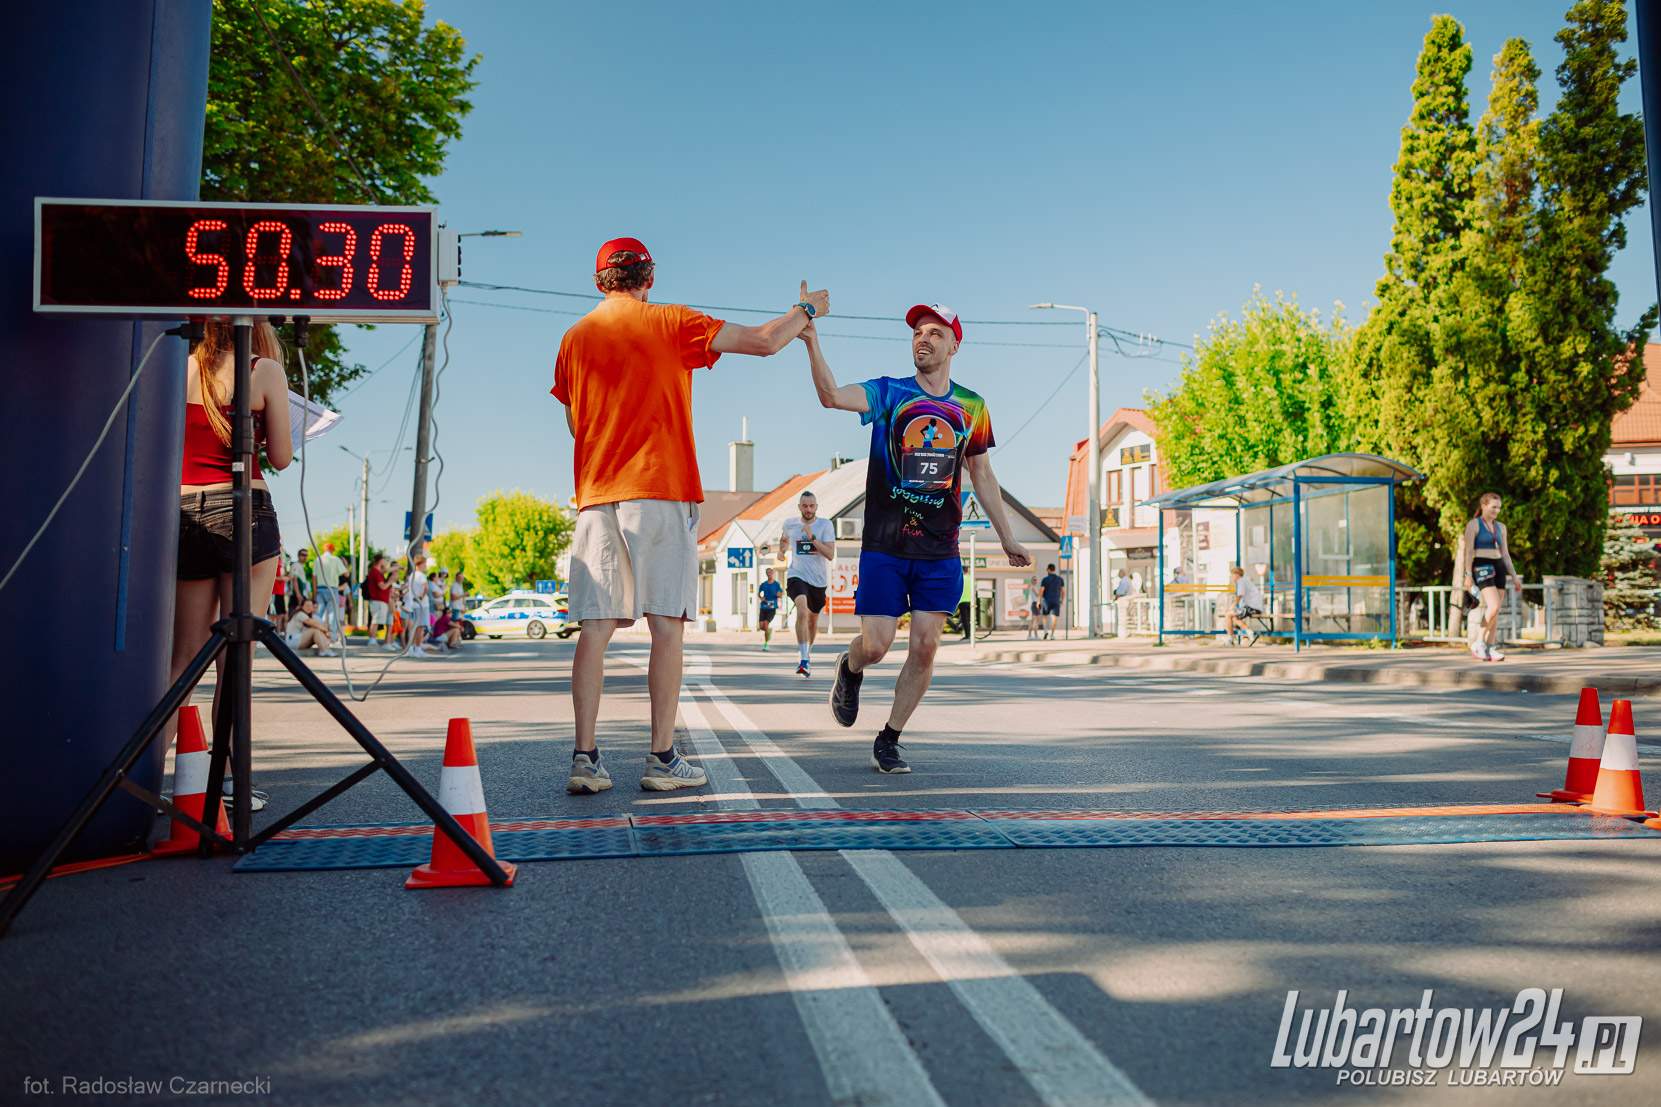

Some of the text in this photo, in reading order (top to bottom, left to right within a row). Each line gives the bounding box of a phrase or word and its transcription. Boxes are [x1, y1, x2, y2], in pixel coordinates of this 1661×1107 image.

[184, 219, 417, 301] 50.30
[920, 462, 938, 475] 75
[909, 516, 918, 526] &
[901, 523, 924, 537] fun
